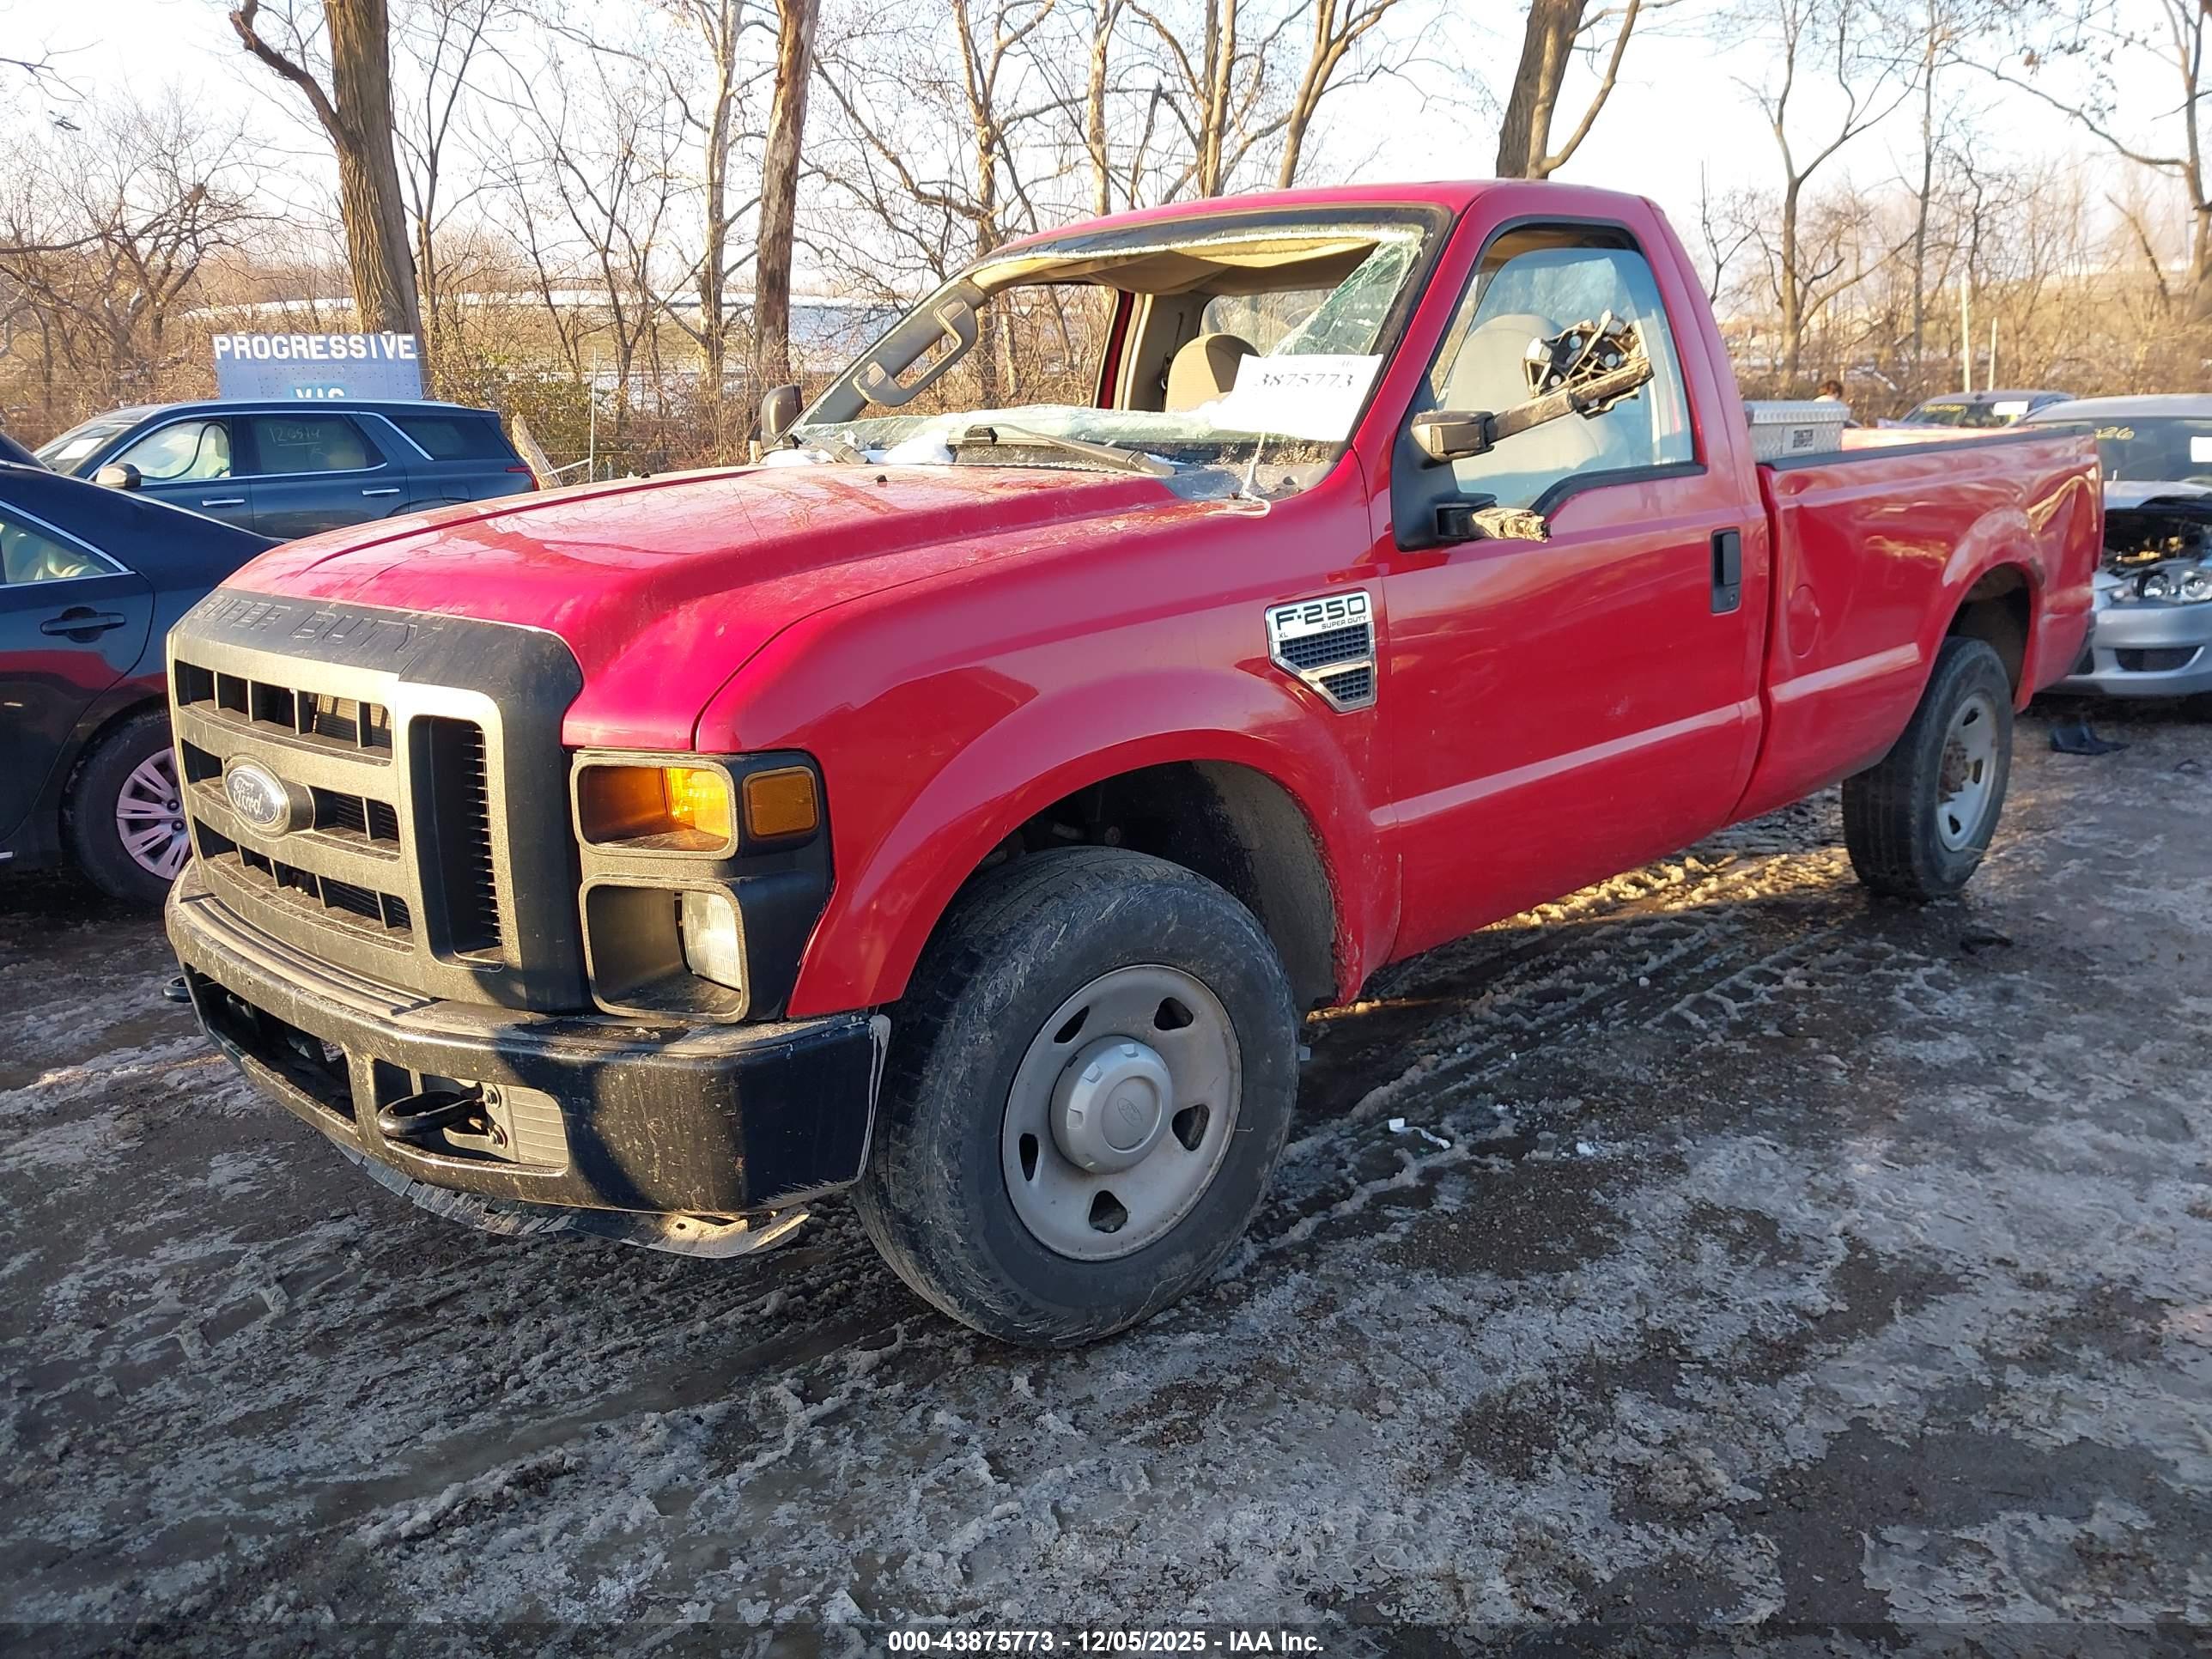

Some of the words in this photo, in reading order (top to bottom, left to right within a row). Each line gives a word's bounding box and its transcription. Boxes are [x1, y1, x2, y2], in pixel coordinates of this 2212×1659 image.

[213, 335, 416, 360] PROGRESSIVE
[1276, 595, 1366, 630] F-250
[1322, 620, 1346, 629] SUPER
[1347, 615, 1367, 624] DUTY
[289, 611, 444, 653] DUTY
[232, 775, 264, 816] Ford
